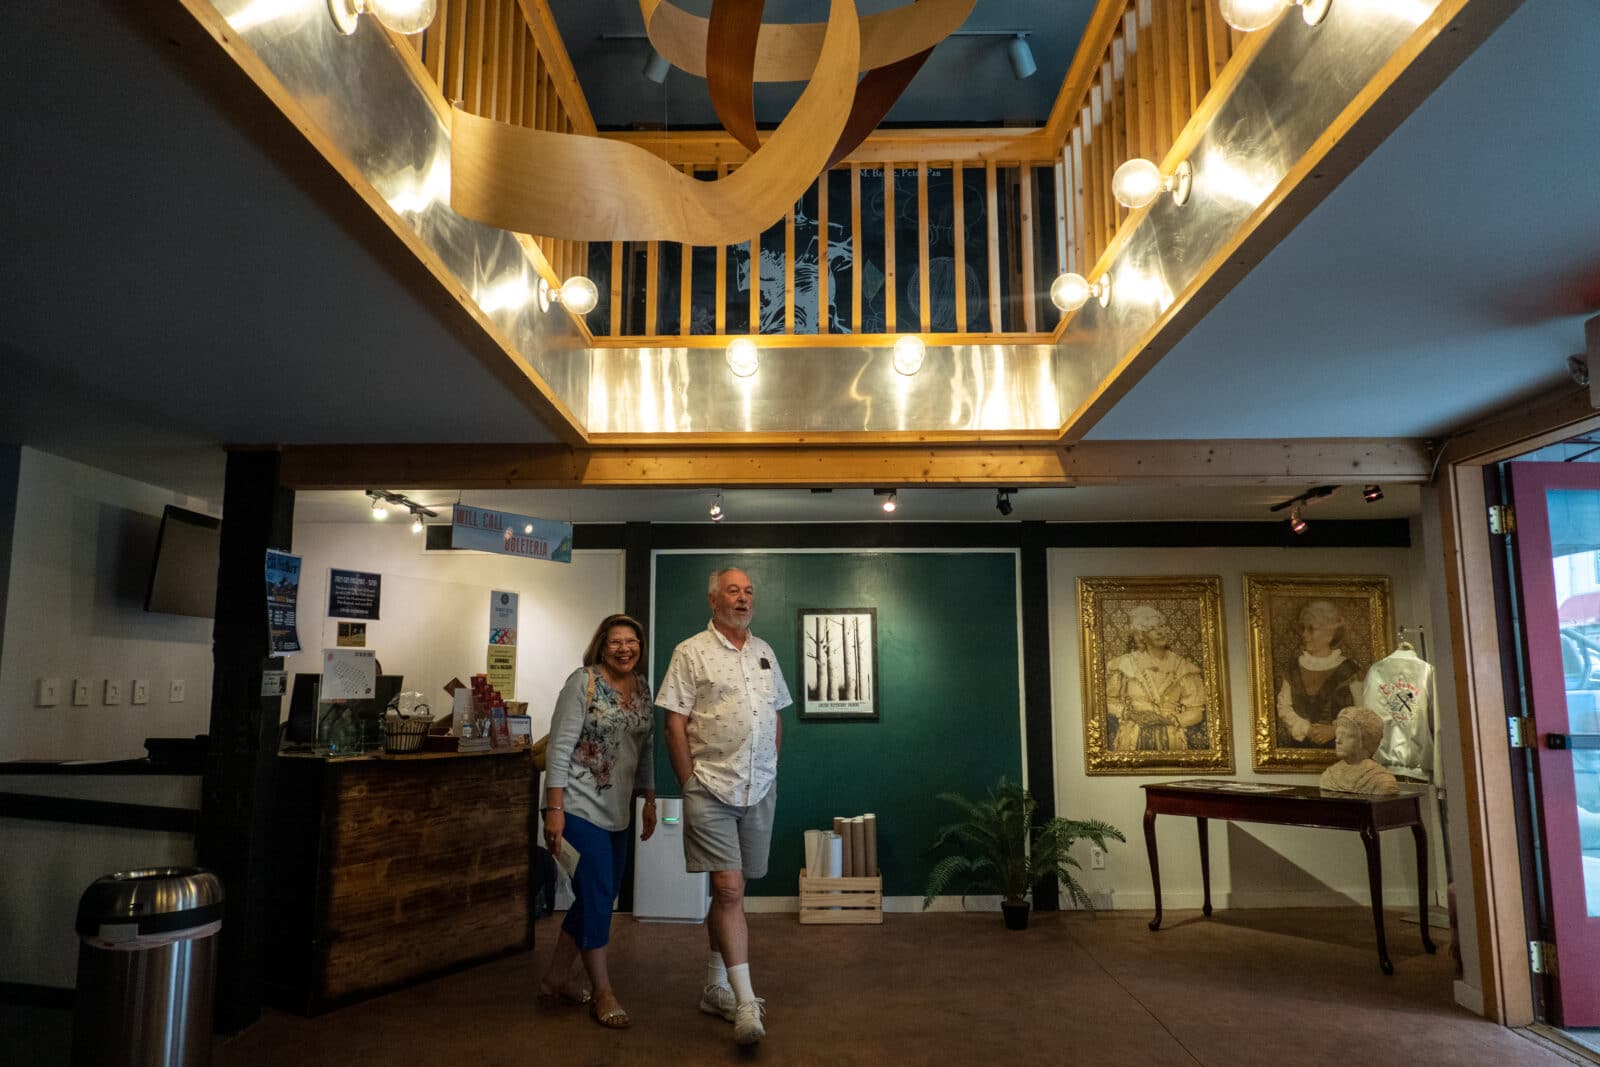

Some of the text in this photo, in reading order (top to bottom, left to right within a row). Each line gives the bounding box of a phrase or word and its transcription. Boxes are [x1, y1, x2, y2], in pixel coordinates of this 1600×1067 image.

[456, 508, 503, 531] WILL CALL
[504, 536, 548, 557] BOLETERIA
